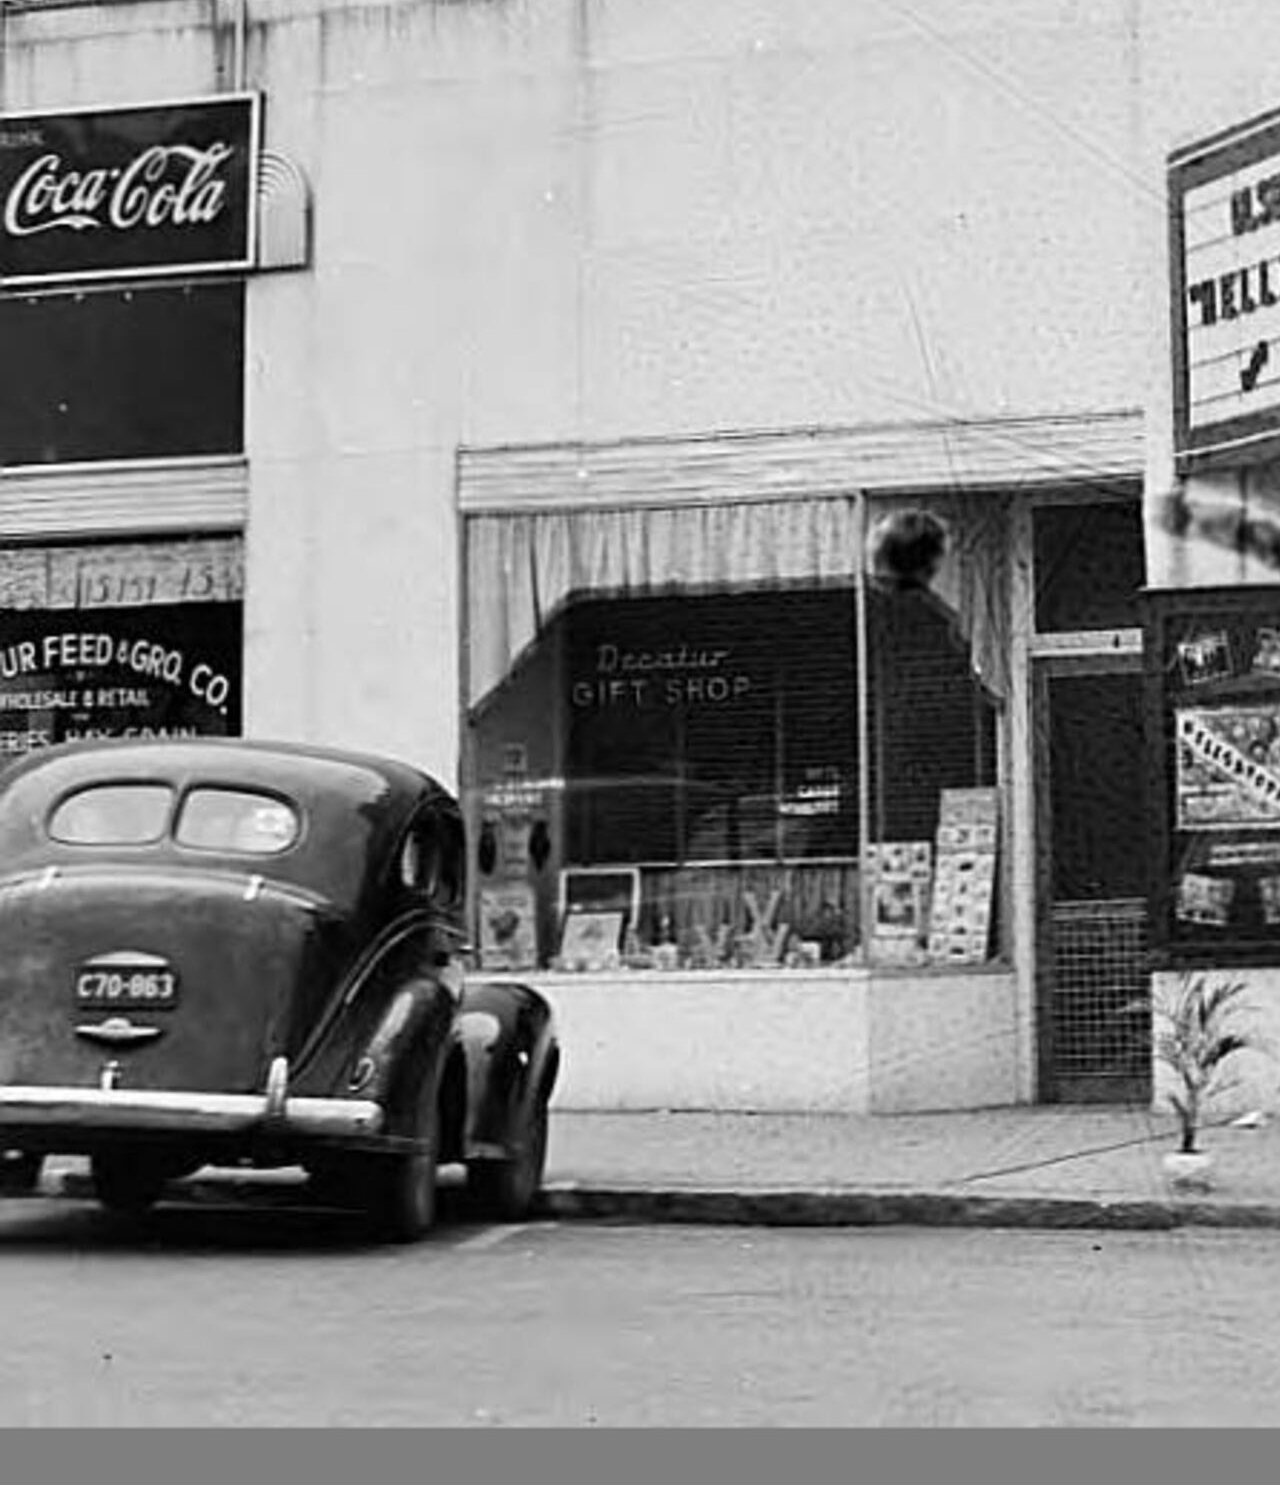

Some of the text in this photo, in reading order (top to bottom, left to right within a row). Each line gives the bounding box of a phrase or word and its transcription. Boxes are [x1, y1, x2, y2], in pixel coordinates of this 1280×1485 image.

[4, 142, 234, 236] Coca-Cola
[43, 632, 113, 668] FEED
[189, 663, 229, 714] CO.
[597, 644, 736, 671] Decatur
[97, 686, 151, 708] RETAIL
[573, 676, 751, 707] GIFT SHOP
